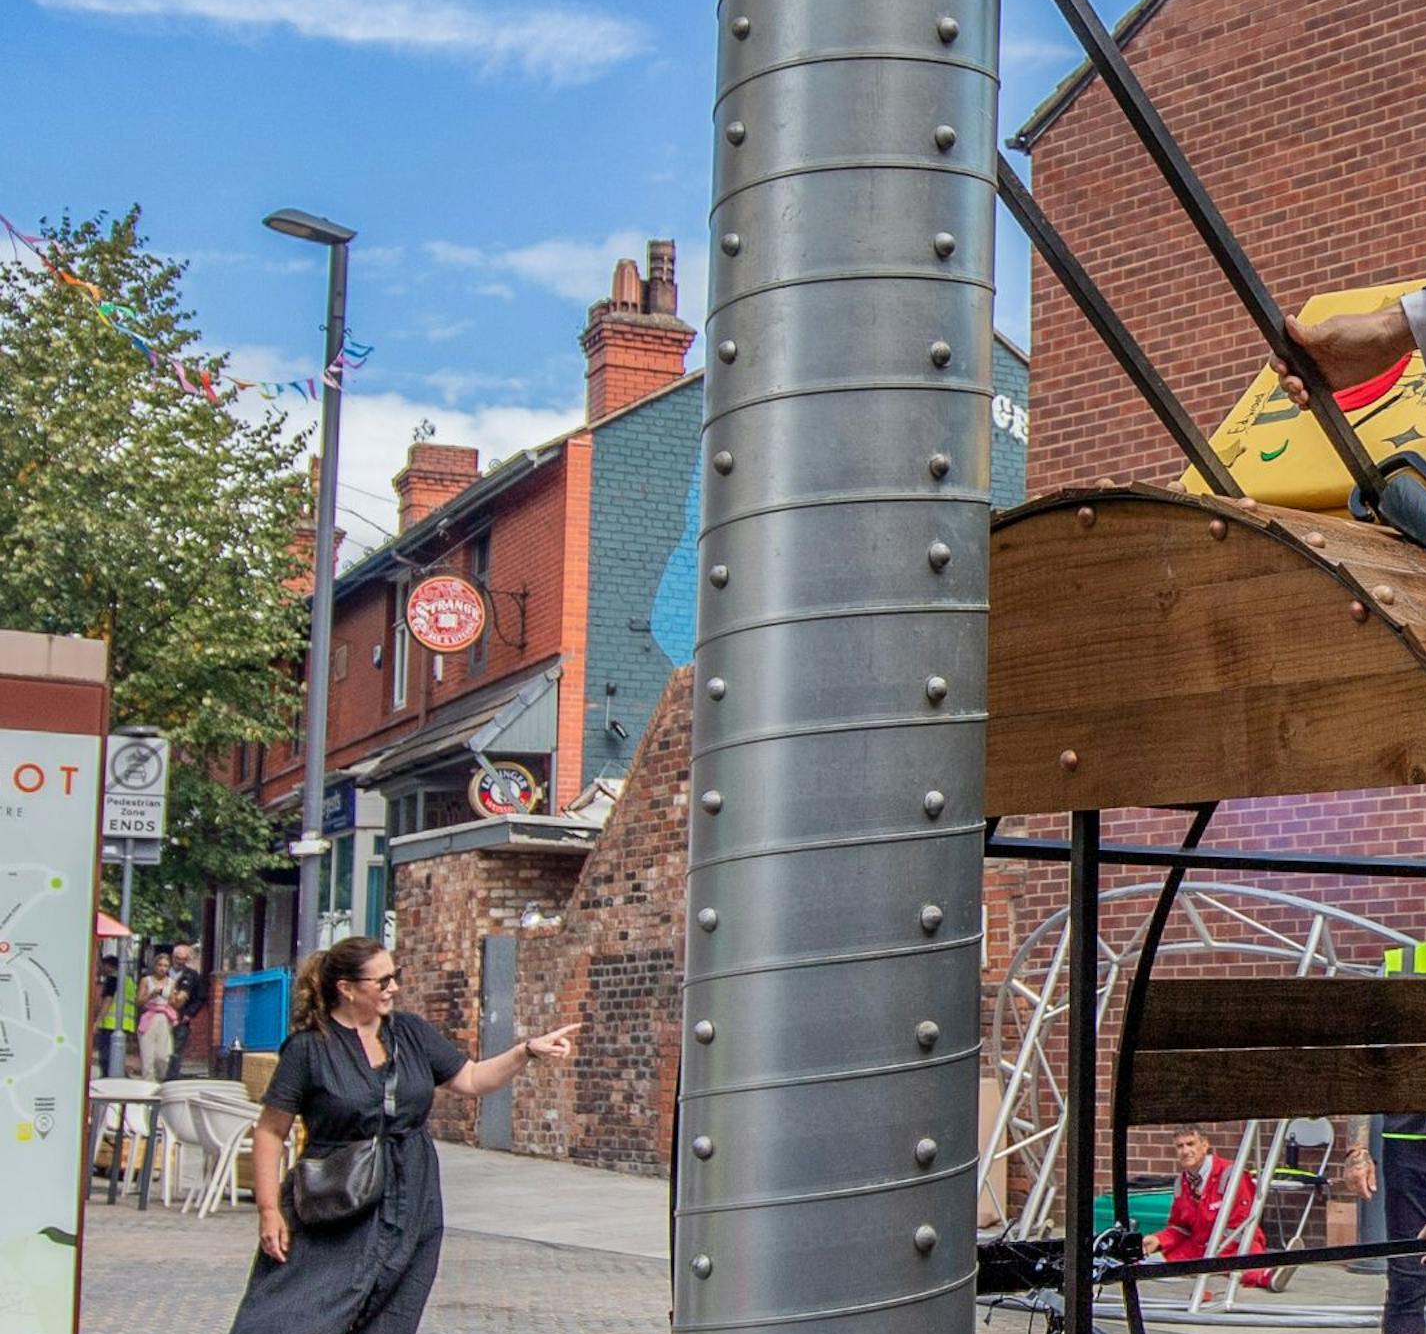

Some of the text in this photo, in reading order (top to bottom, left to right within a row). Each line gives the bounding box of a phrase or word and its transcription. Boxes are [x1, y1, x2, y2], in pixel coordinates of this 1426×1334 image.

[13, 762, 79, 795] OT
[481, 769, 528, 790] ERINGER
[107, 796, 161, 808] Pedestrian
[0, 805, 23, 818] RE
[120, 808, 146, 817] Zone
[109, 819, 156, 832] ENDS
